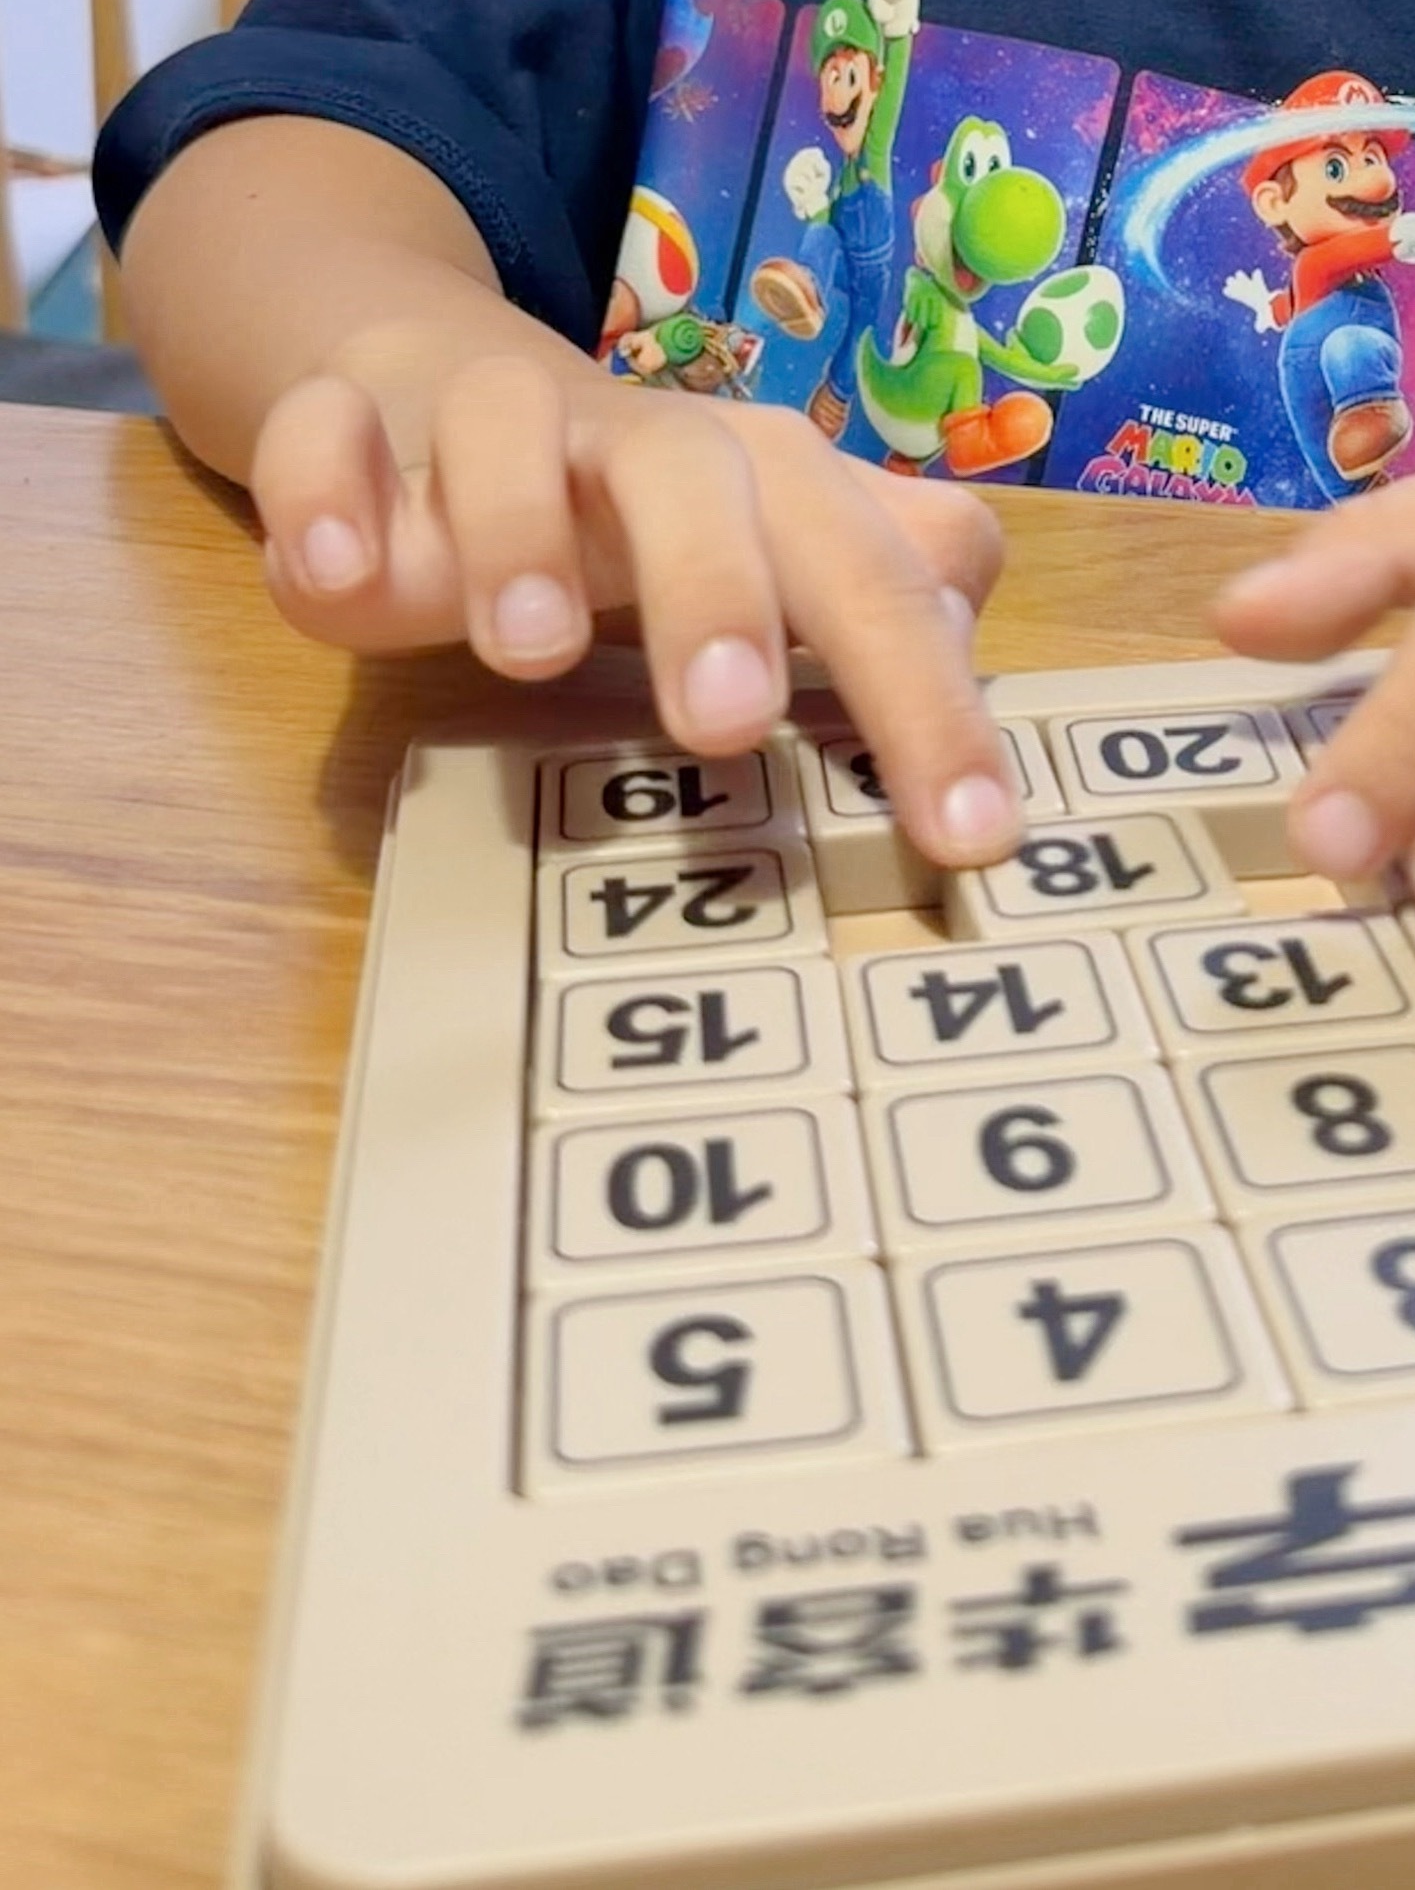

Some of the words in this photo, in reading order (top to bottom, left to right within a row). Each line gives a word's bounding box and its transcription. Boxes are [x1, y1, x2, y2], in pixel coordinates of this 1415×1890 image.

[1105, 418, 1248, 486] MARIO
[1139, 403, 1175, 428] THE
[1174, 413, 1233, 441] SUPER
[1097, 722, 1243, 781] 20
[600, 764, 730, 822] 19
[589, 863, 758, 939] 24
[1014, 831, 1156, 898] 18
[909, 963, 1064, 1044] 14
[1201, 938, 1353, 1013] 13
[604, 990, 759, 1071] 15
[977, 1105, 1076, 1194] 9
[1289, 1073, 1393, 1158] 8
[605, 1138, 772, 1232] 10
[1018, 1280, 1126, 1384] 4
[648, 1315, 751, 1428] 5
[732, 1522, 930, 1572] Rong
[953, 1501, 1101, 1545] Hua
[551, 1547, 702, 1592] Dao
